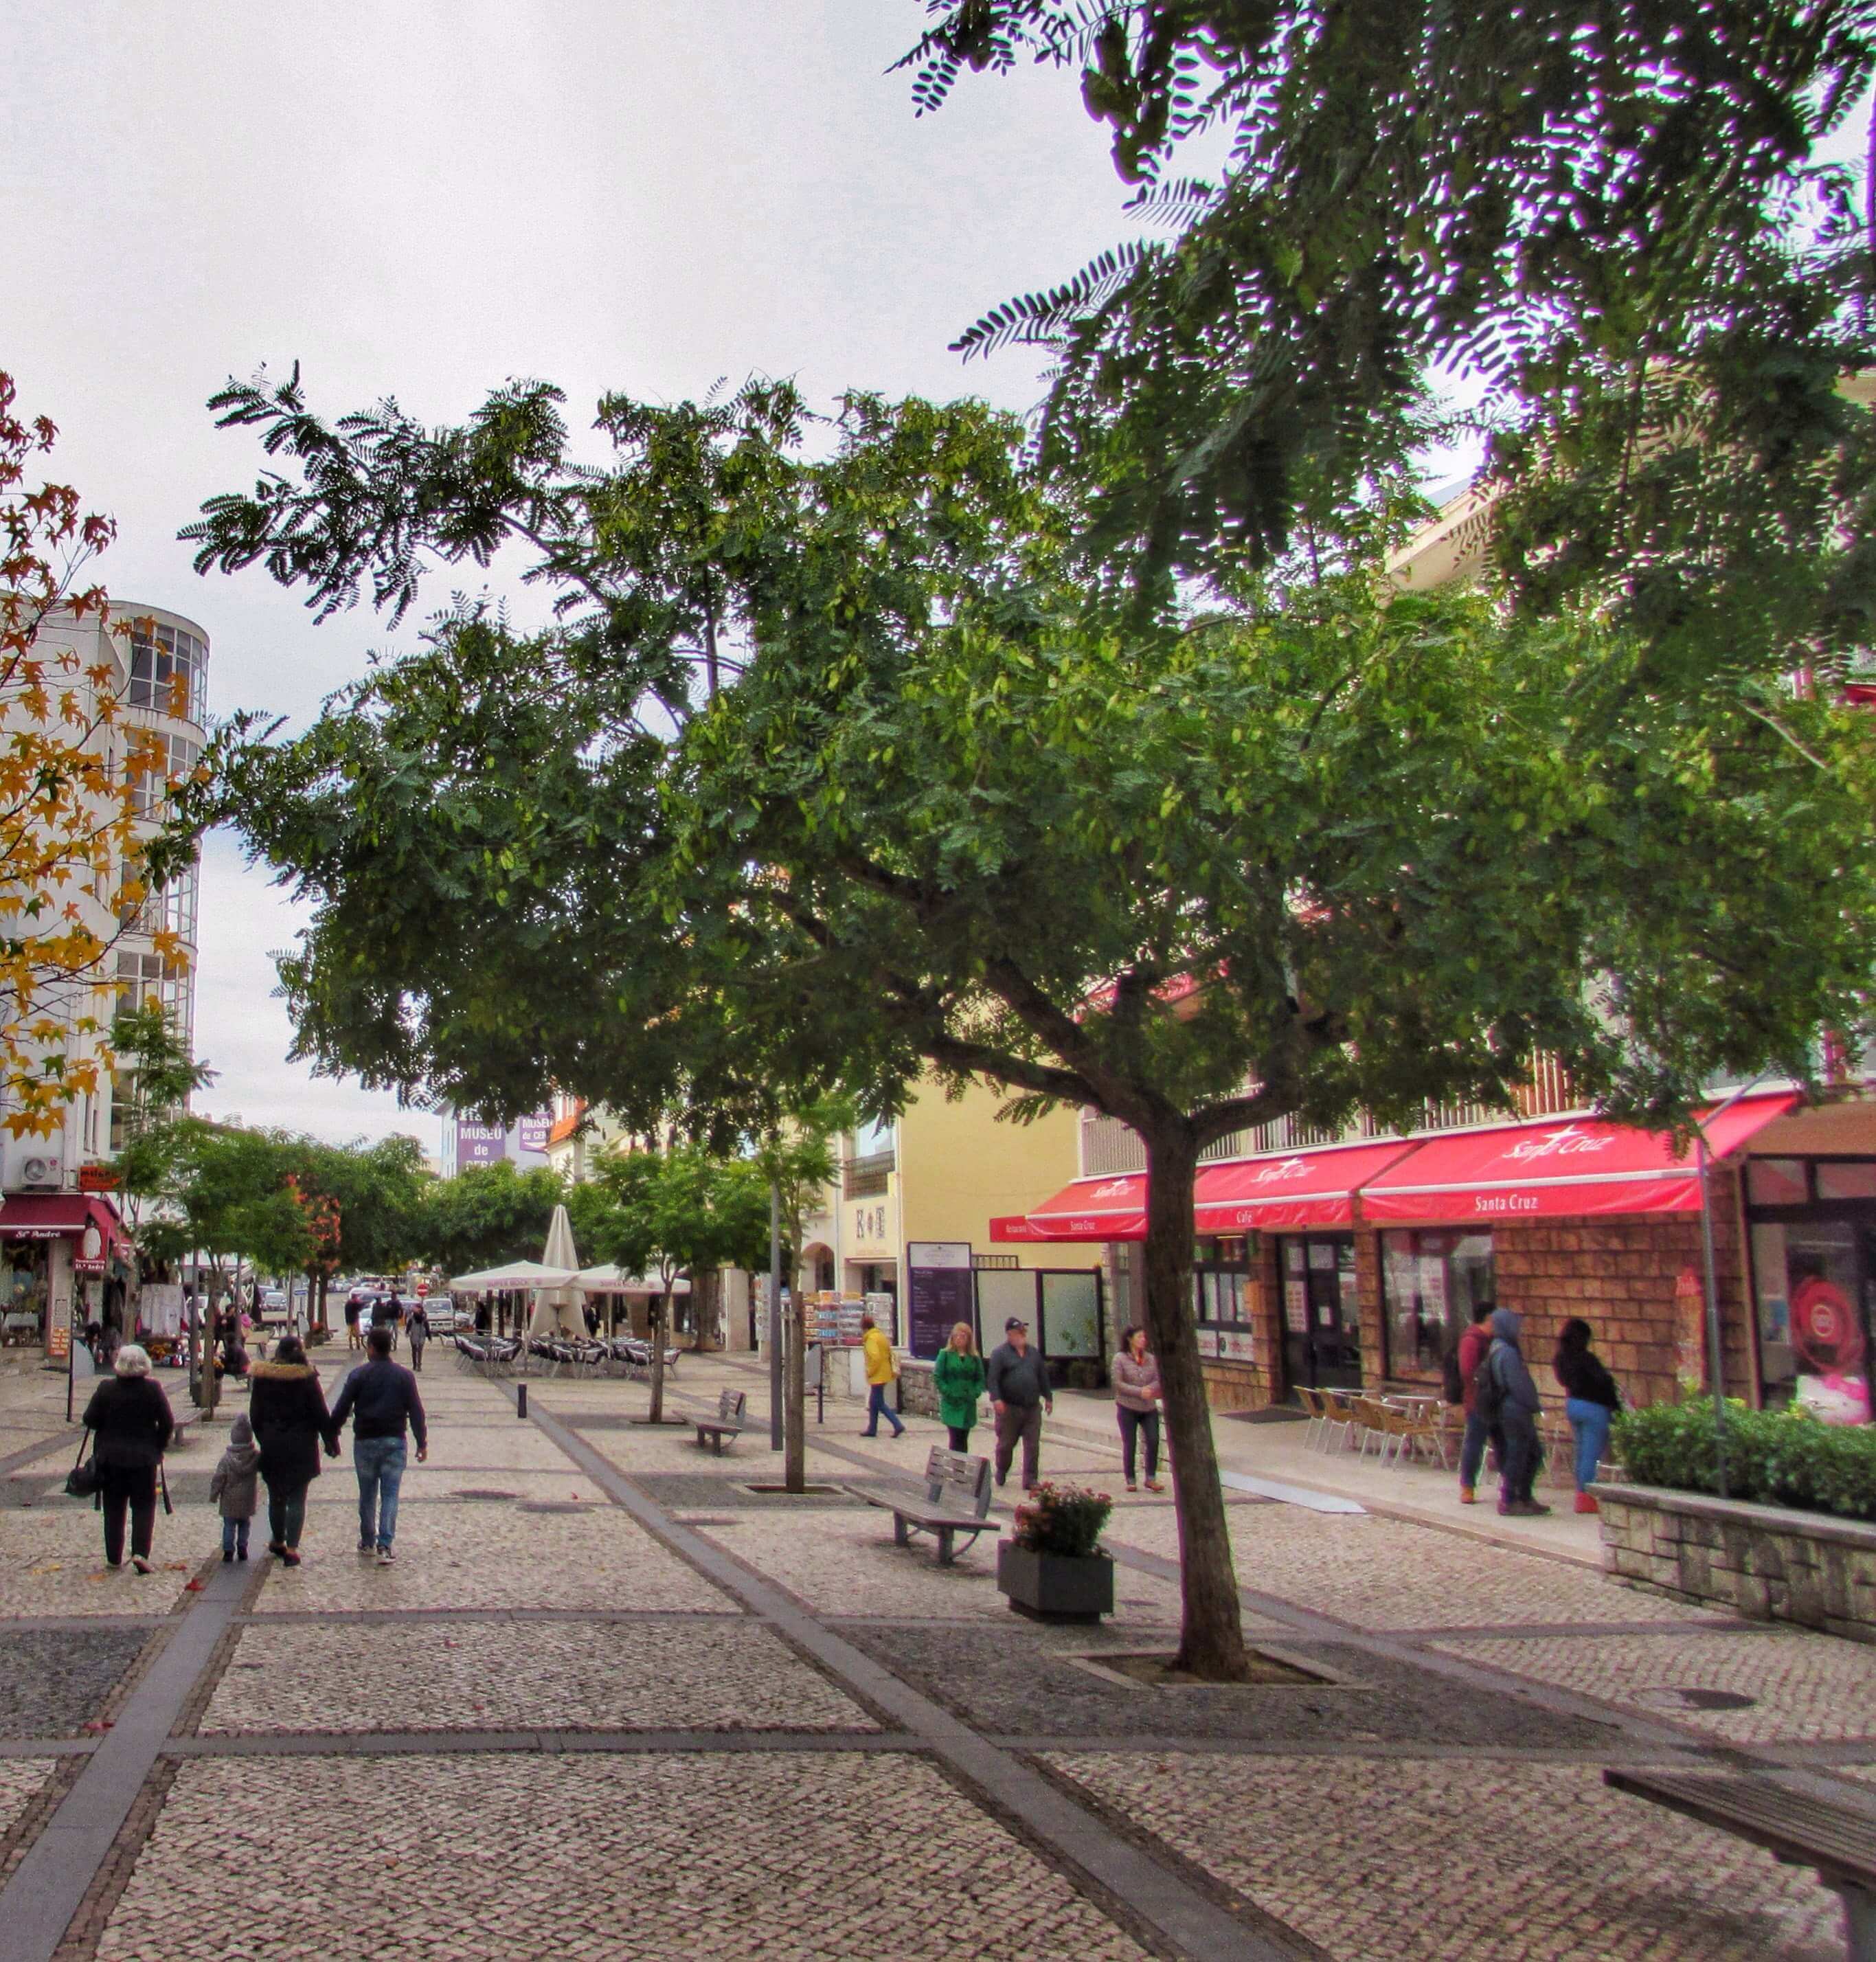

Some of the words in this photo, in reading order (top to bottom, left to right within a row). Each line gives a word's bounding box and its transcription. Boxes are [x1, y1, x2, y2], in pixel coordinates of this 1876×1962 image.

[461, 1127, 501, 1140] MUSEU
[474, 1144, 488, 1155] de
[1559, 1136, 1616, 1154] Cruz
[1476, 1195, 1506, 1211] Santa
[1509, 1194, 1538, 1209] Cruz
[1236, 1209, 1254, 1224] Café
